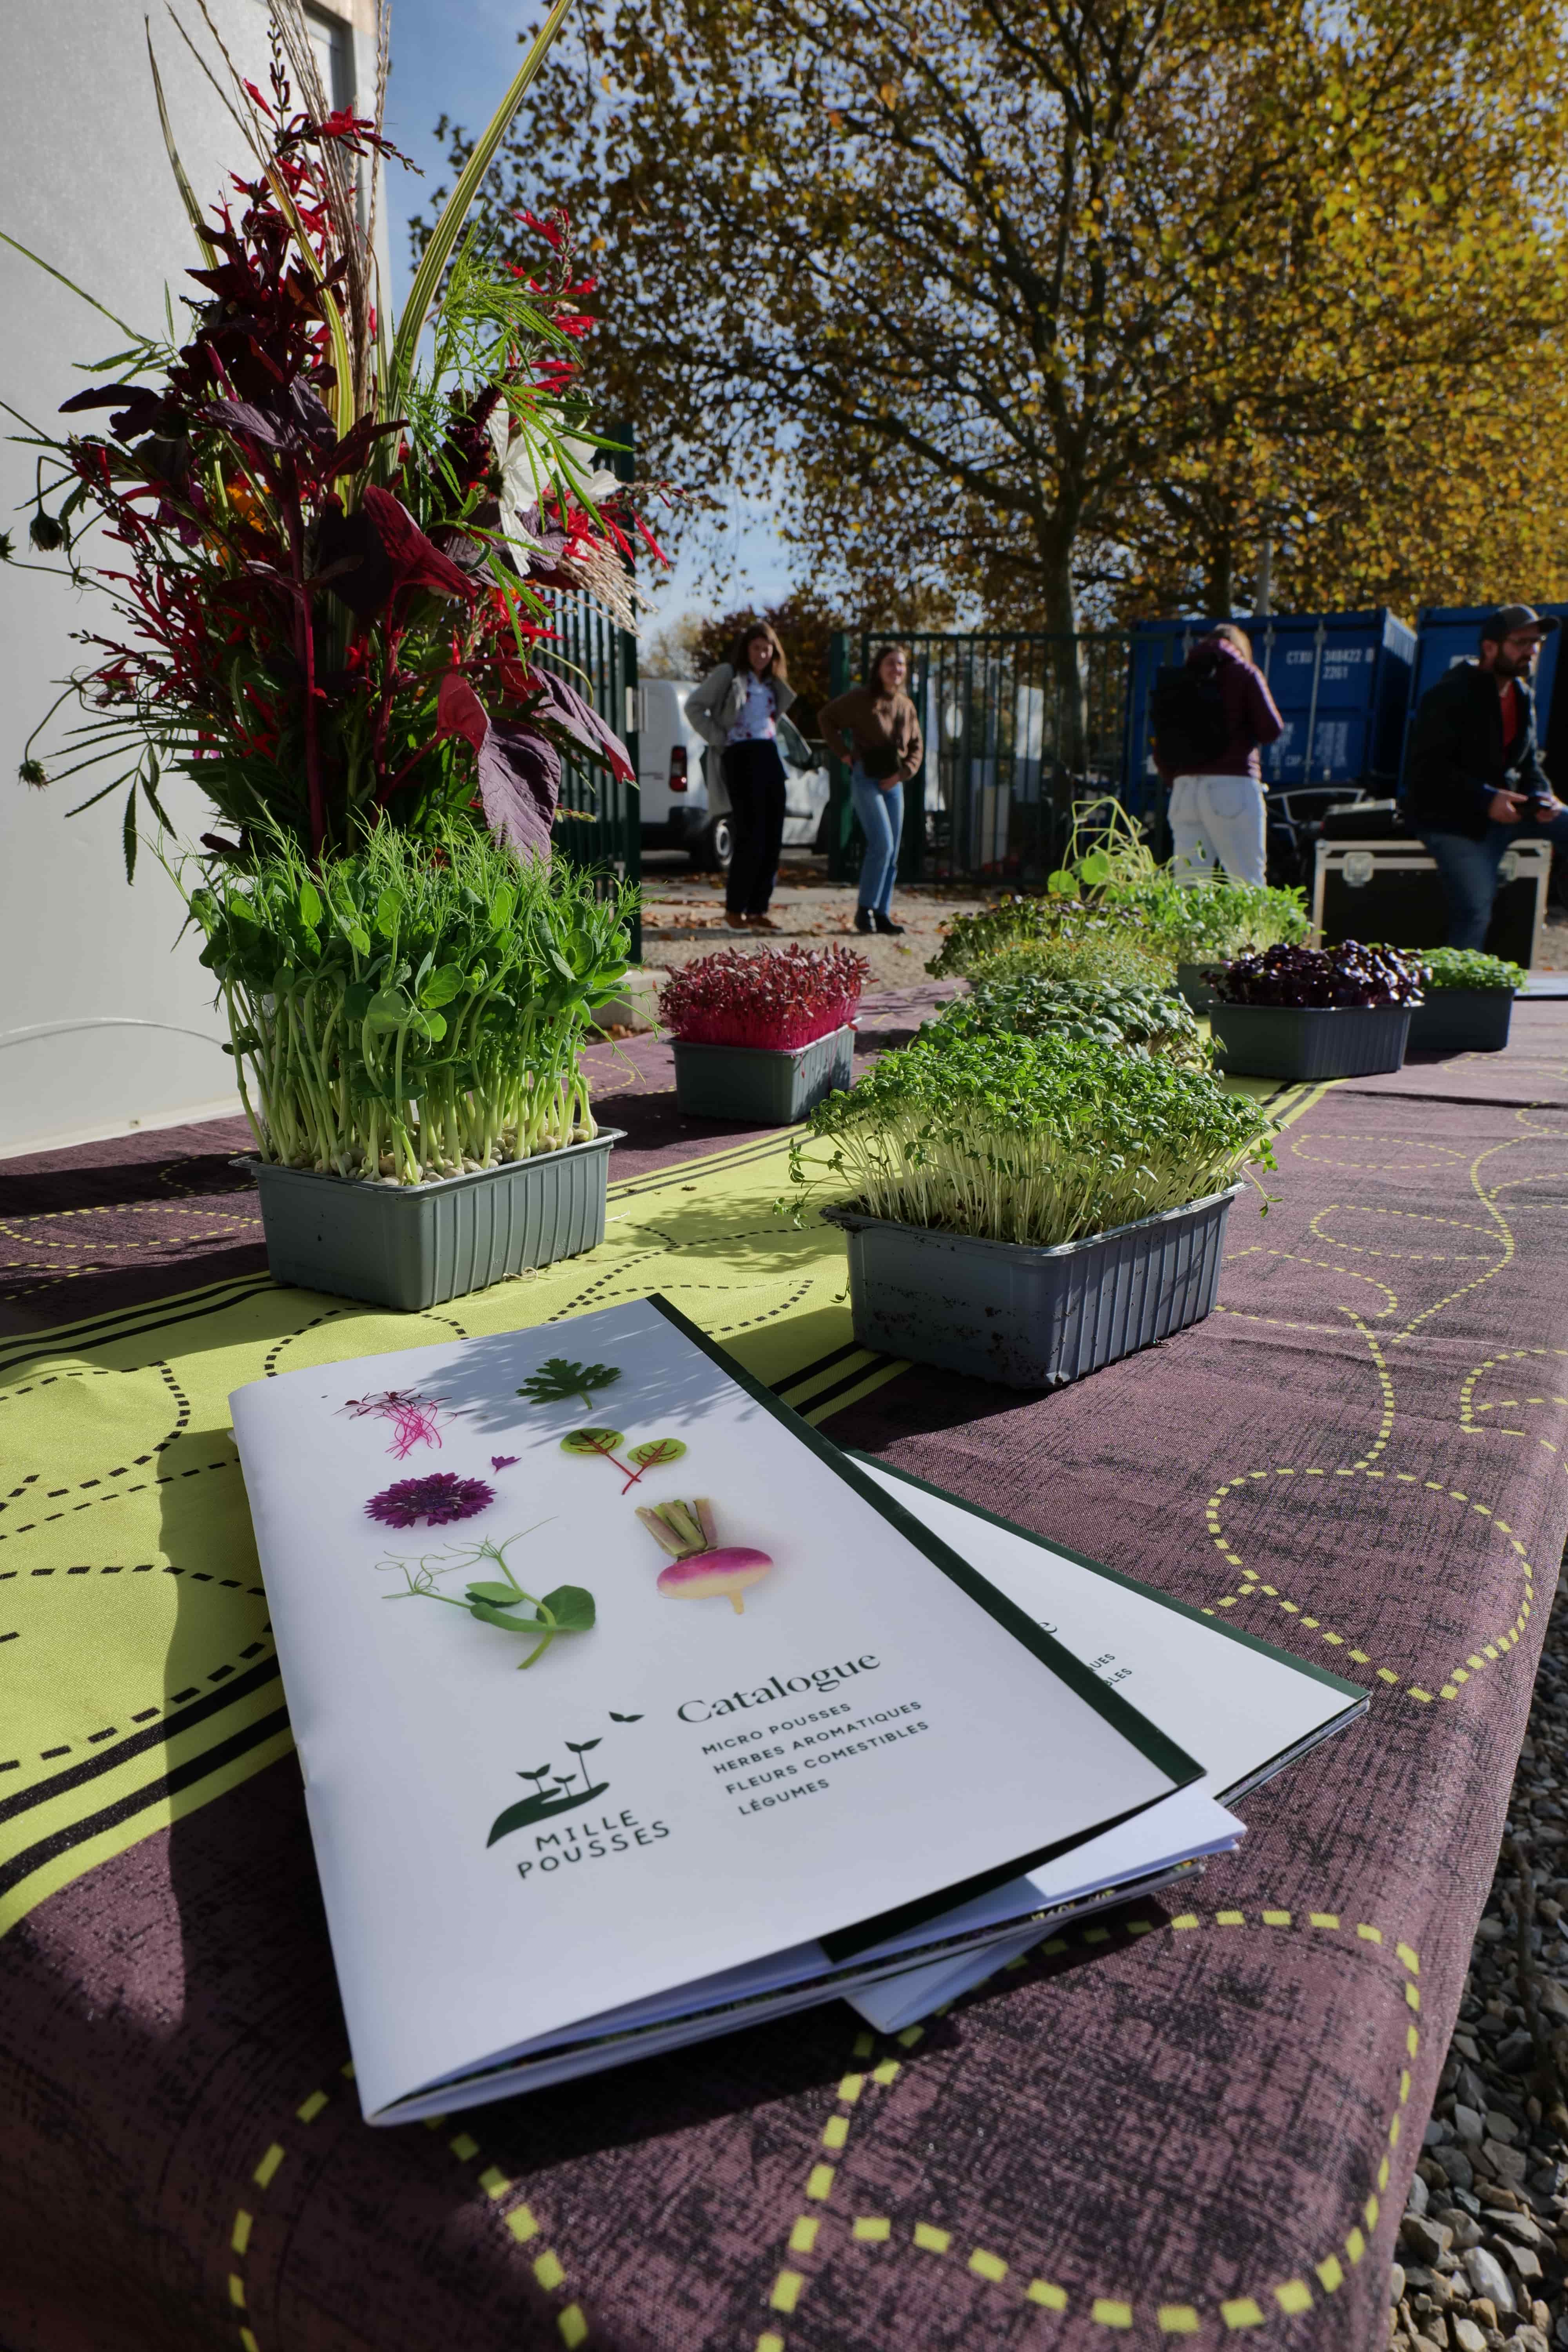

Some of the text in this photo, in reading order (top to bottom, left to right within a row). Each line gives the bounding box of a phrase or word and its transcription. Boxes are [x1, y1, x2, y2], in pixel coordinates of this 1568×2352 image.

[677, 1655, 881, 1723] Catalogue
[701, 1703, 852, 1756] MICRO POUSSES
[712, 1701, 922, 1775] HERBES AROMATIQUES
[725, 1721, 929, 1795] FLEURS COMESTIBLES
[737, 1779, 830, 1816] LÉGUMES
[516, 1820, 671, 1880] POUSSES
[535, 1809, 639, 1853] MILLE
